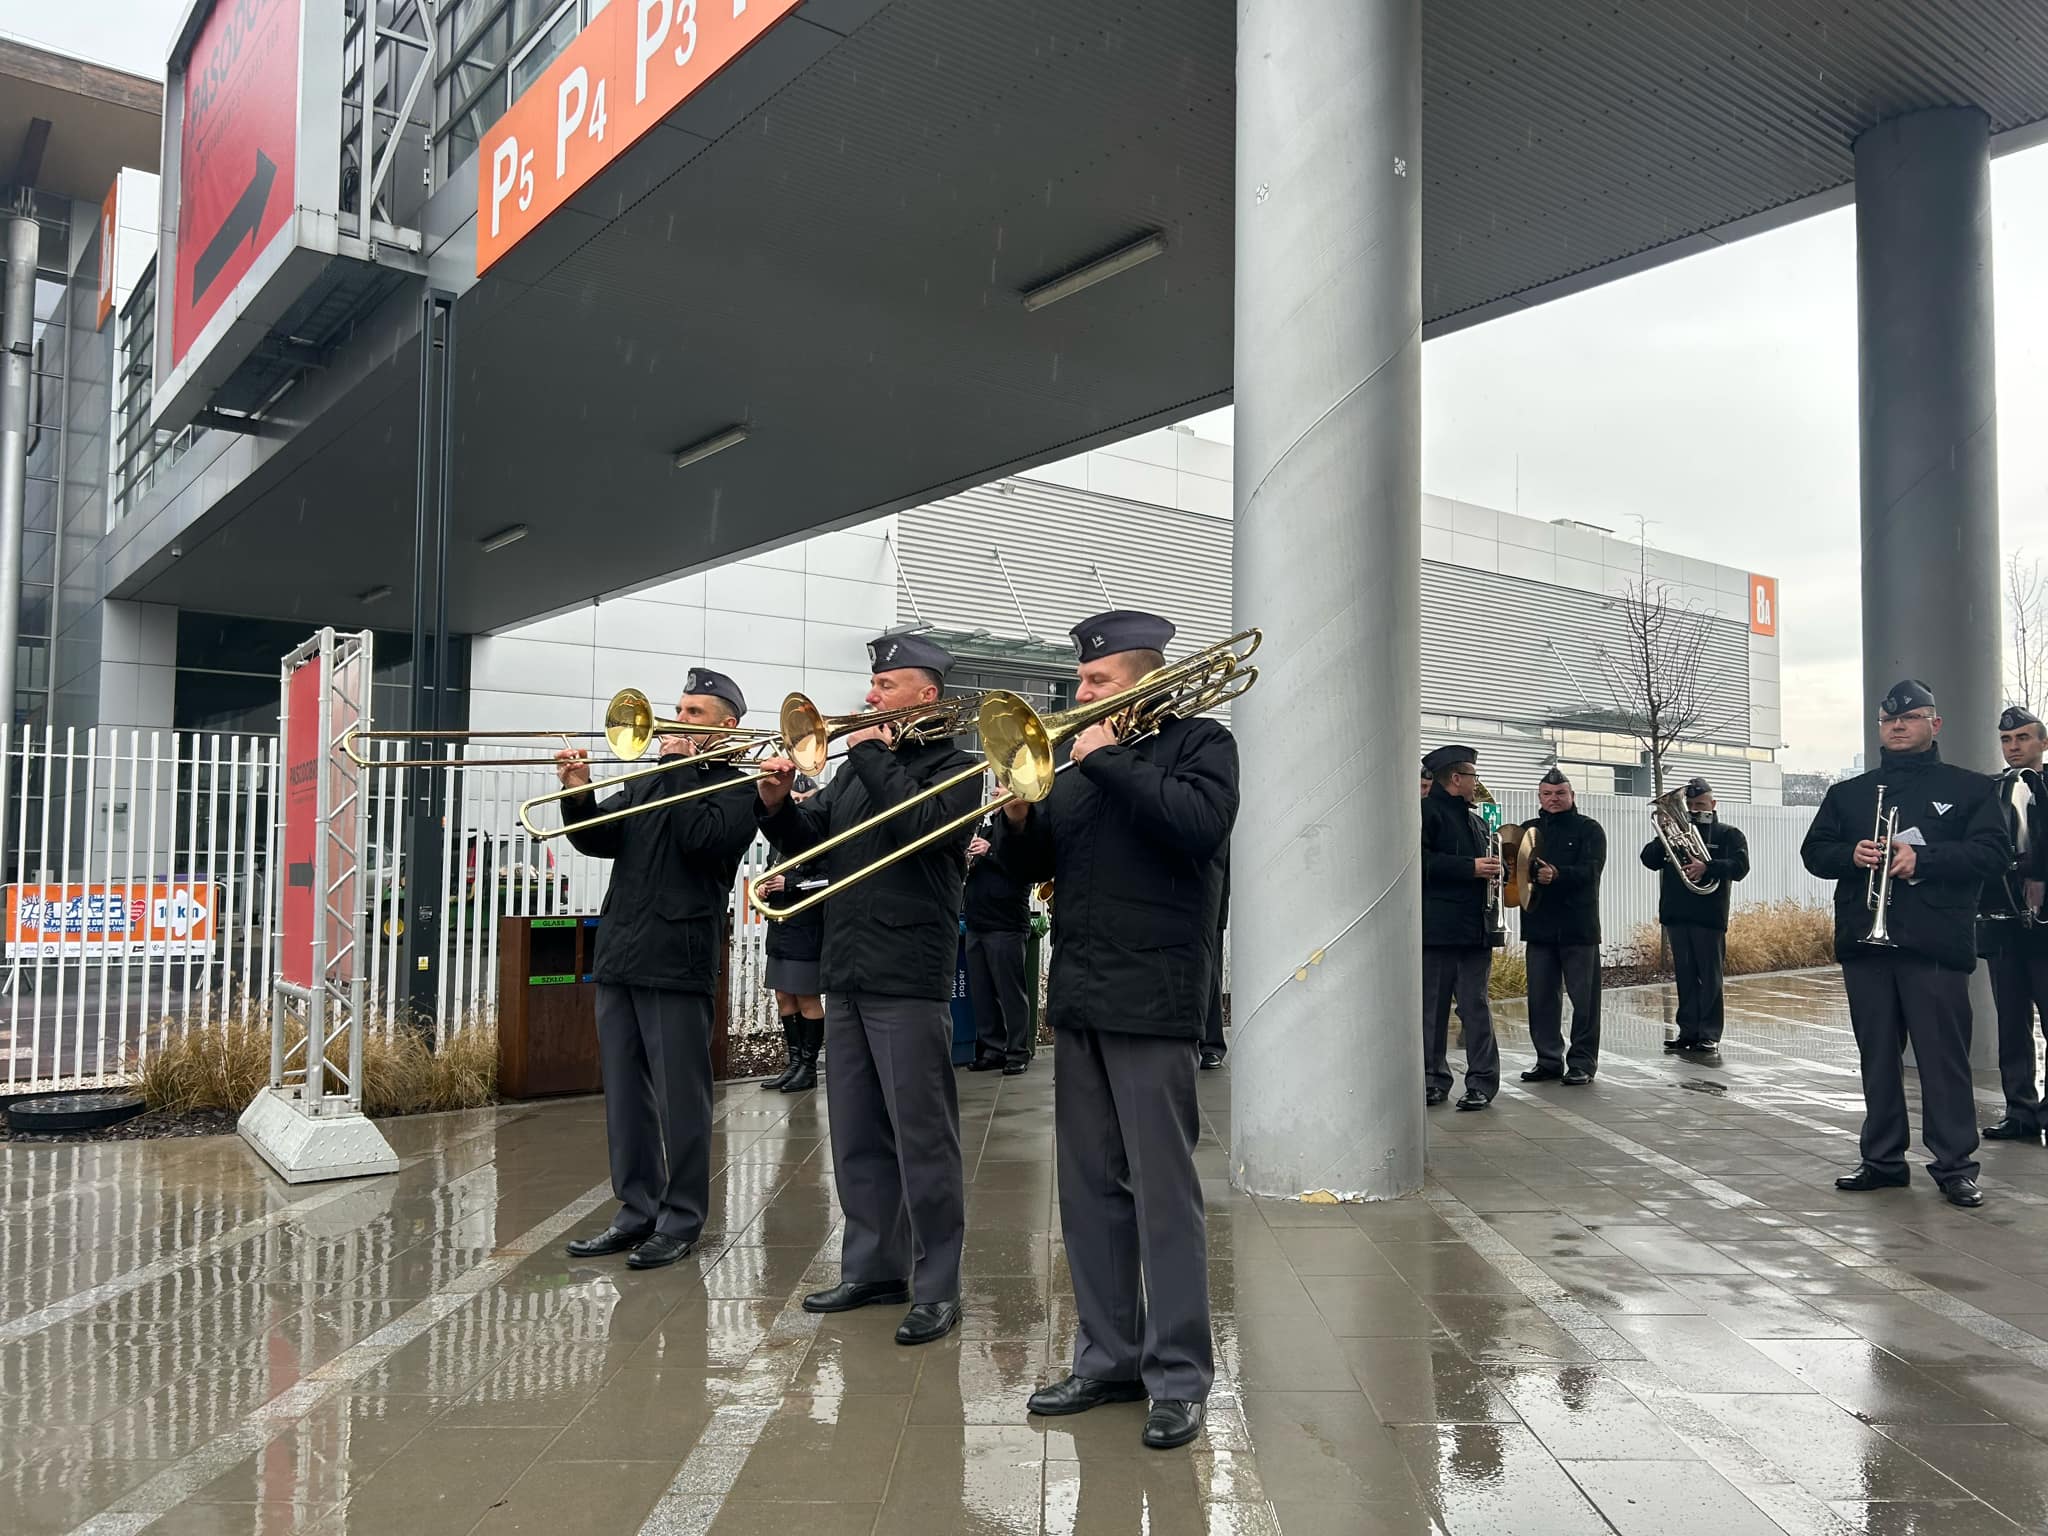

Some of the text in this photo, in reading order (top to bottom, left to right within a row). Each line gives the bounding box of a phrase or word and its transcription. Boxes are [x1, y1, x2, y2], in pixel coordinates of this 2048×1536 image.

[491, 136, 534, 237] P5
[556, 66, 606, 180] P4
[1756, 585, 1771, 625] 8A
